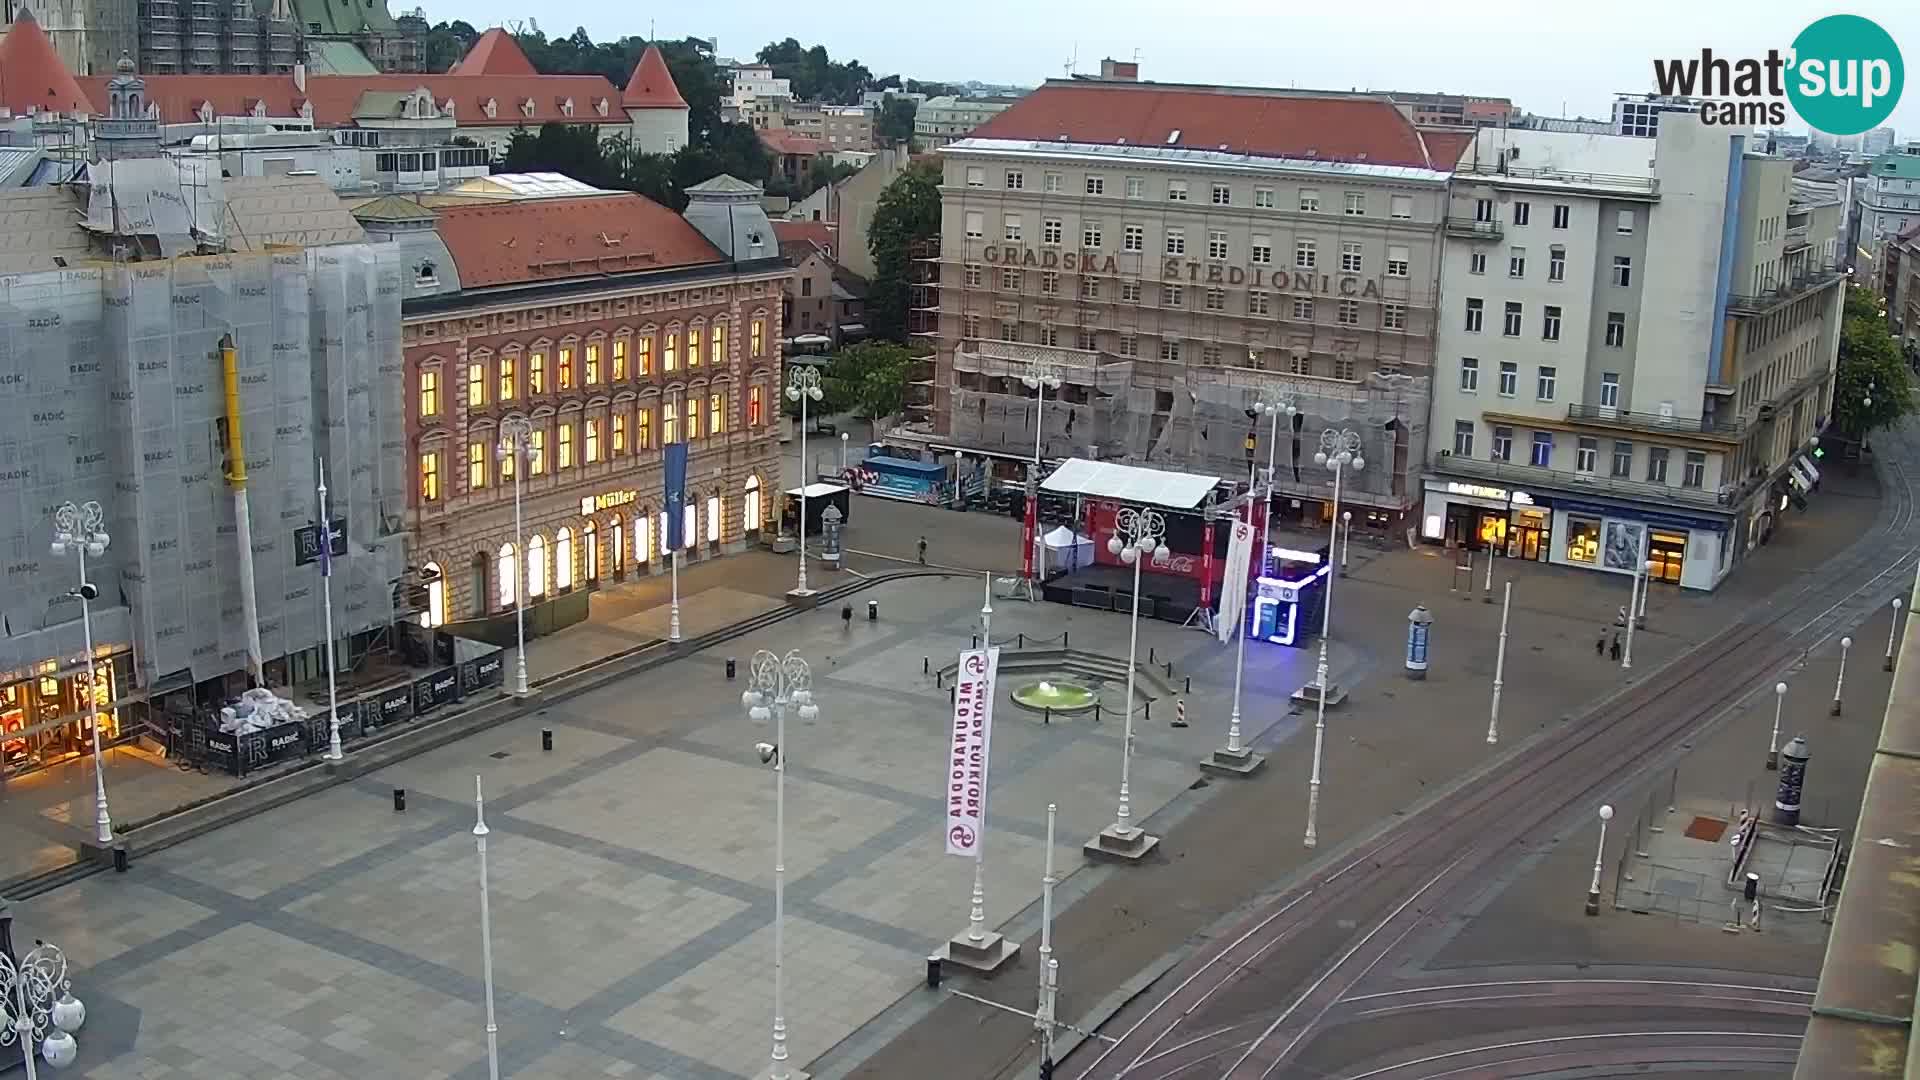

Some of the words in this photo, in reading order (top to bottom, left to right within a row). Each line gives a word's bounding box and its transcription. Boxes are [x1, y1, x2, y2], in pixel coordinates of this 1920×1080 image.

[983, 245, 1118, 275] GRADSKA
[29, 313, 62, 328] RADIĆ
[33, 409, 65, 422] RADIĆ
[595, 490, 637, 511] Müller
[271, 731, 299, 748] RADIĆ
